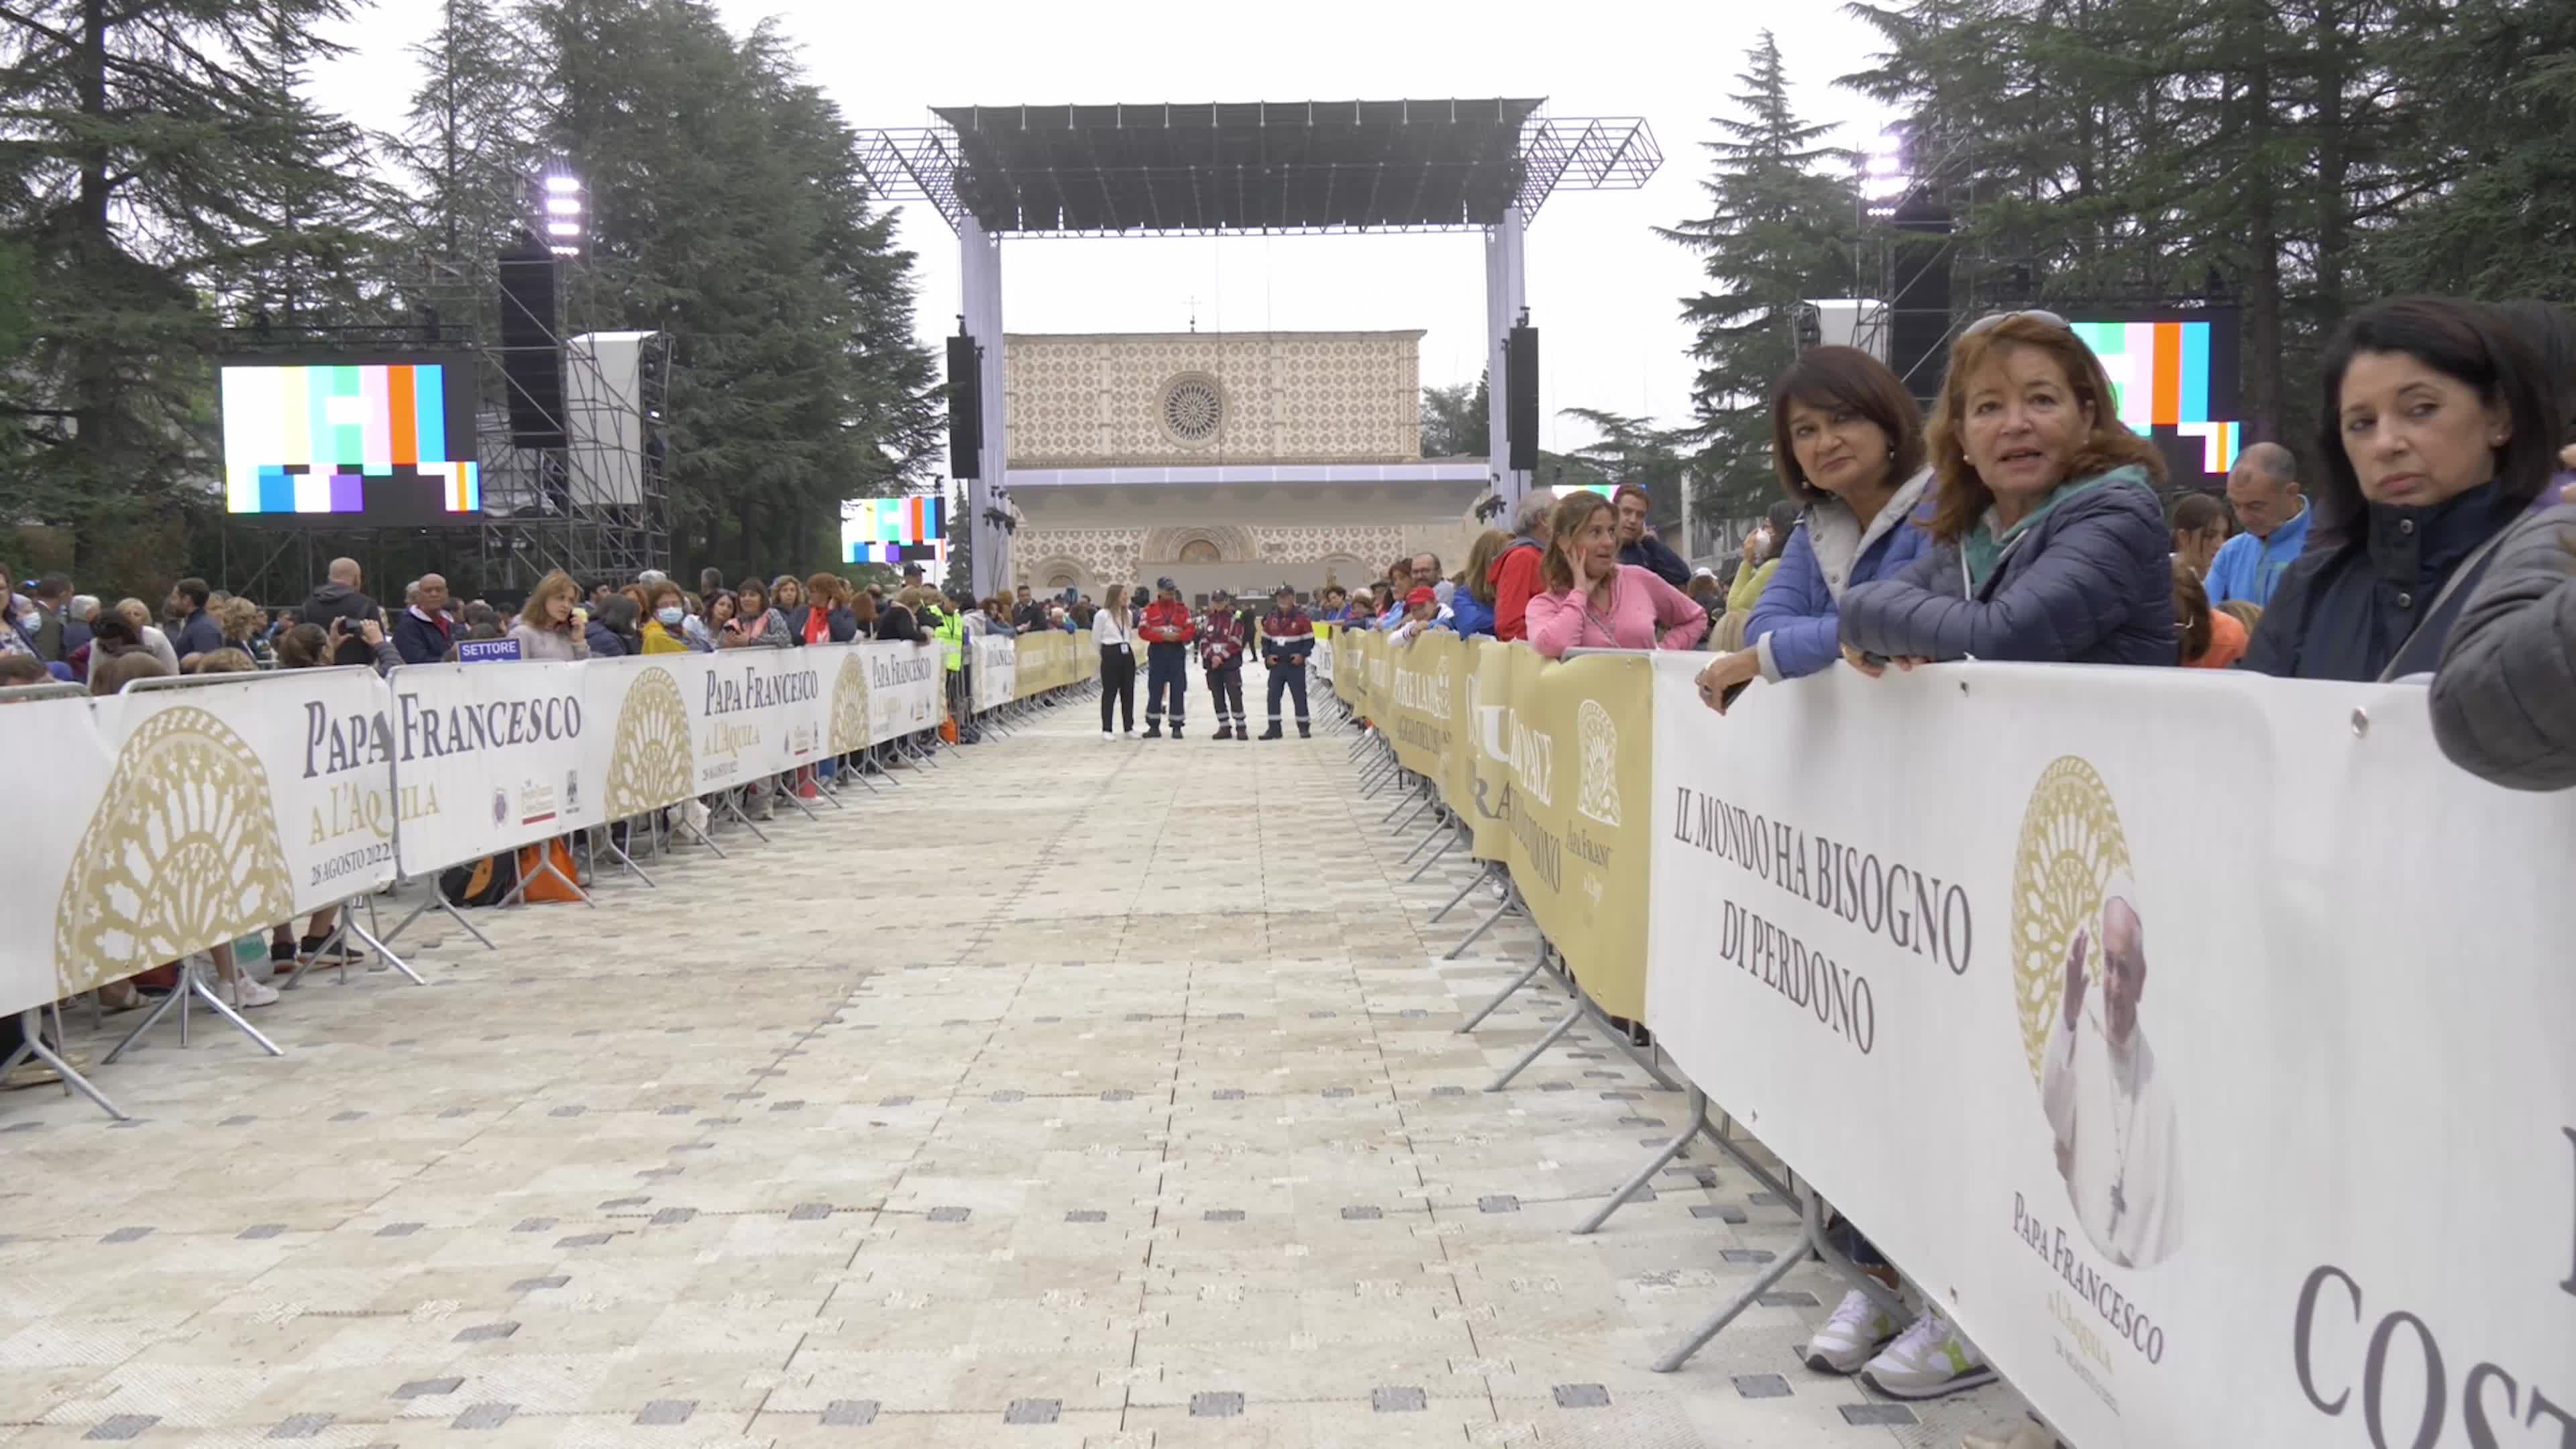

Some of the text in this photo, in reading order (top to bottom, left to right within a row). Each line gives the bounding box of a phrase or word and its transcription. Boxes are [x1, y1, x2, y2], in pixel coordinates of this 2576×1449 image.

[462, 641, 517, 657] SETTORE
[704, 666, 818, 716] PAPA FRANCESCO
[303, 692, 582, 778] PAPA FRANCESCO
[309, 780, 441, 845] A L'AQILA
[323, 848, 365, 881] AGOSTO
[1674, 786, 1972, 975] IL MONDO HA BISOGNO
[1719, 899, 1874, 1055] DI PERDONO
[2013, 1191, 2163, 1364] PAPA FRANCESCO
